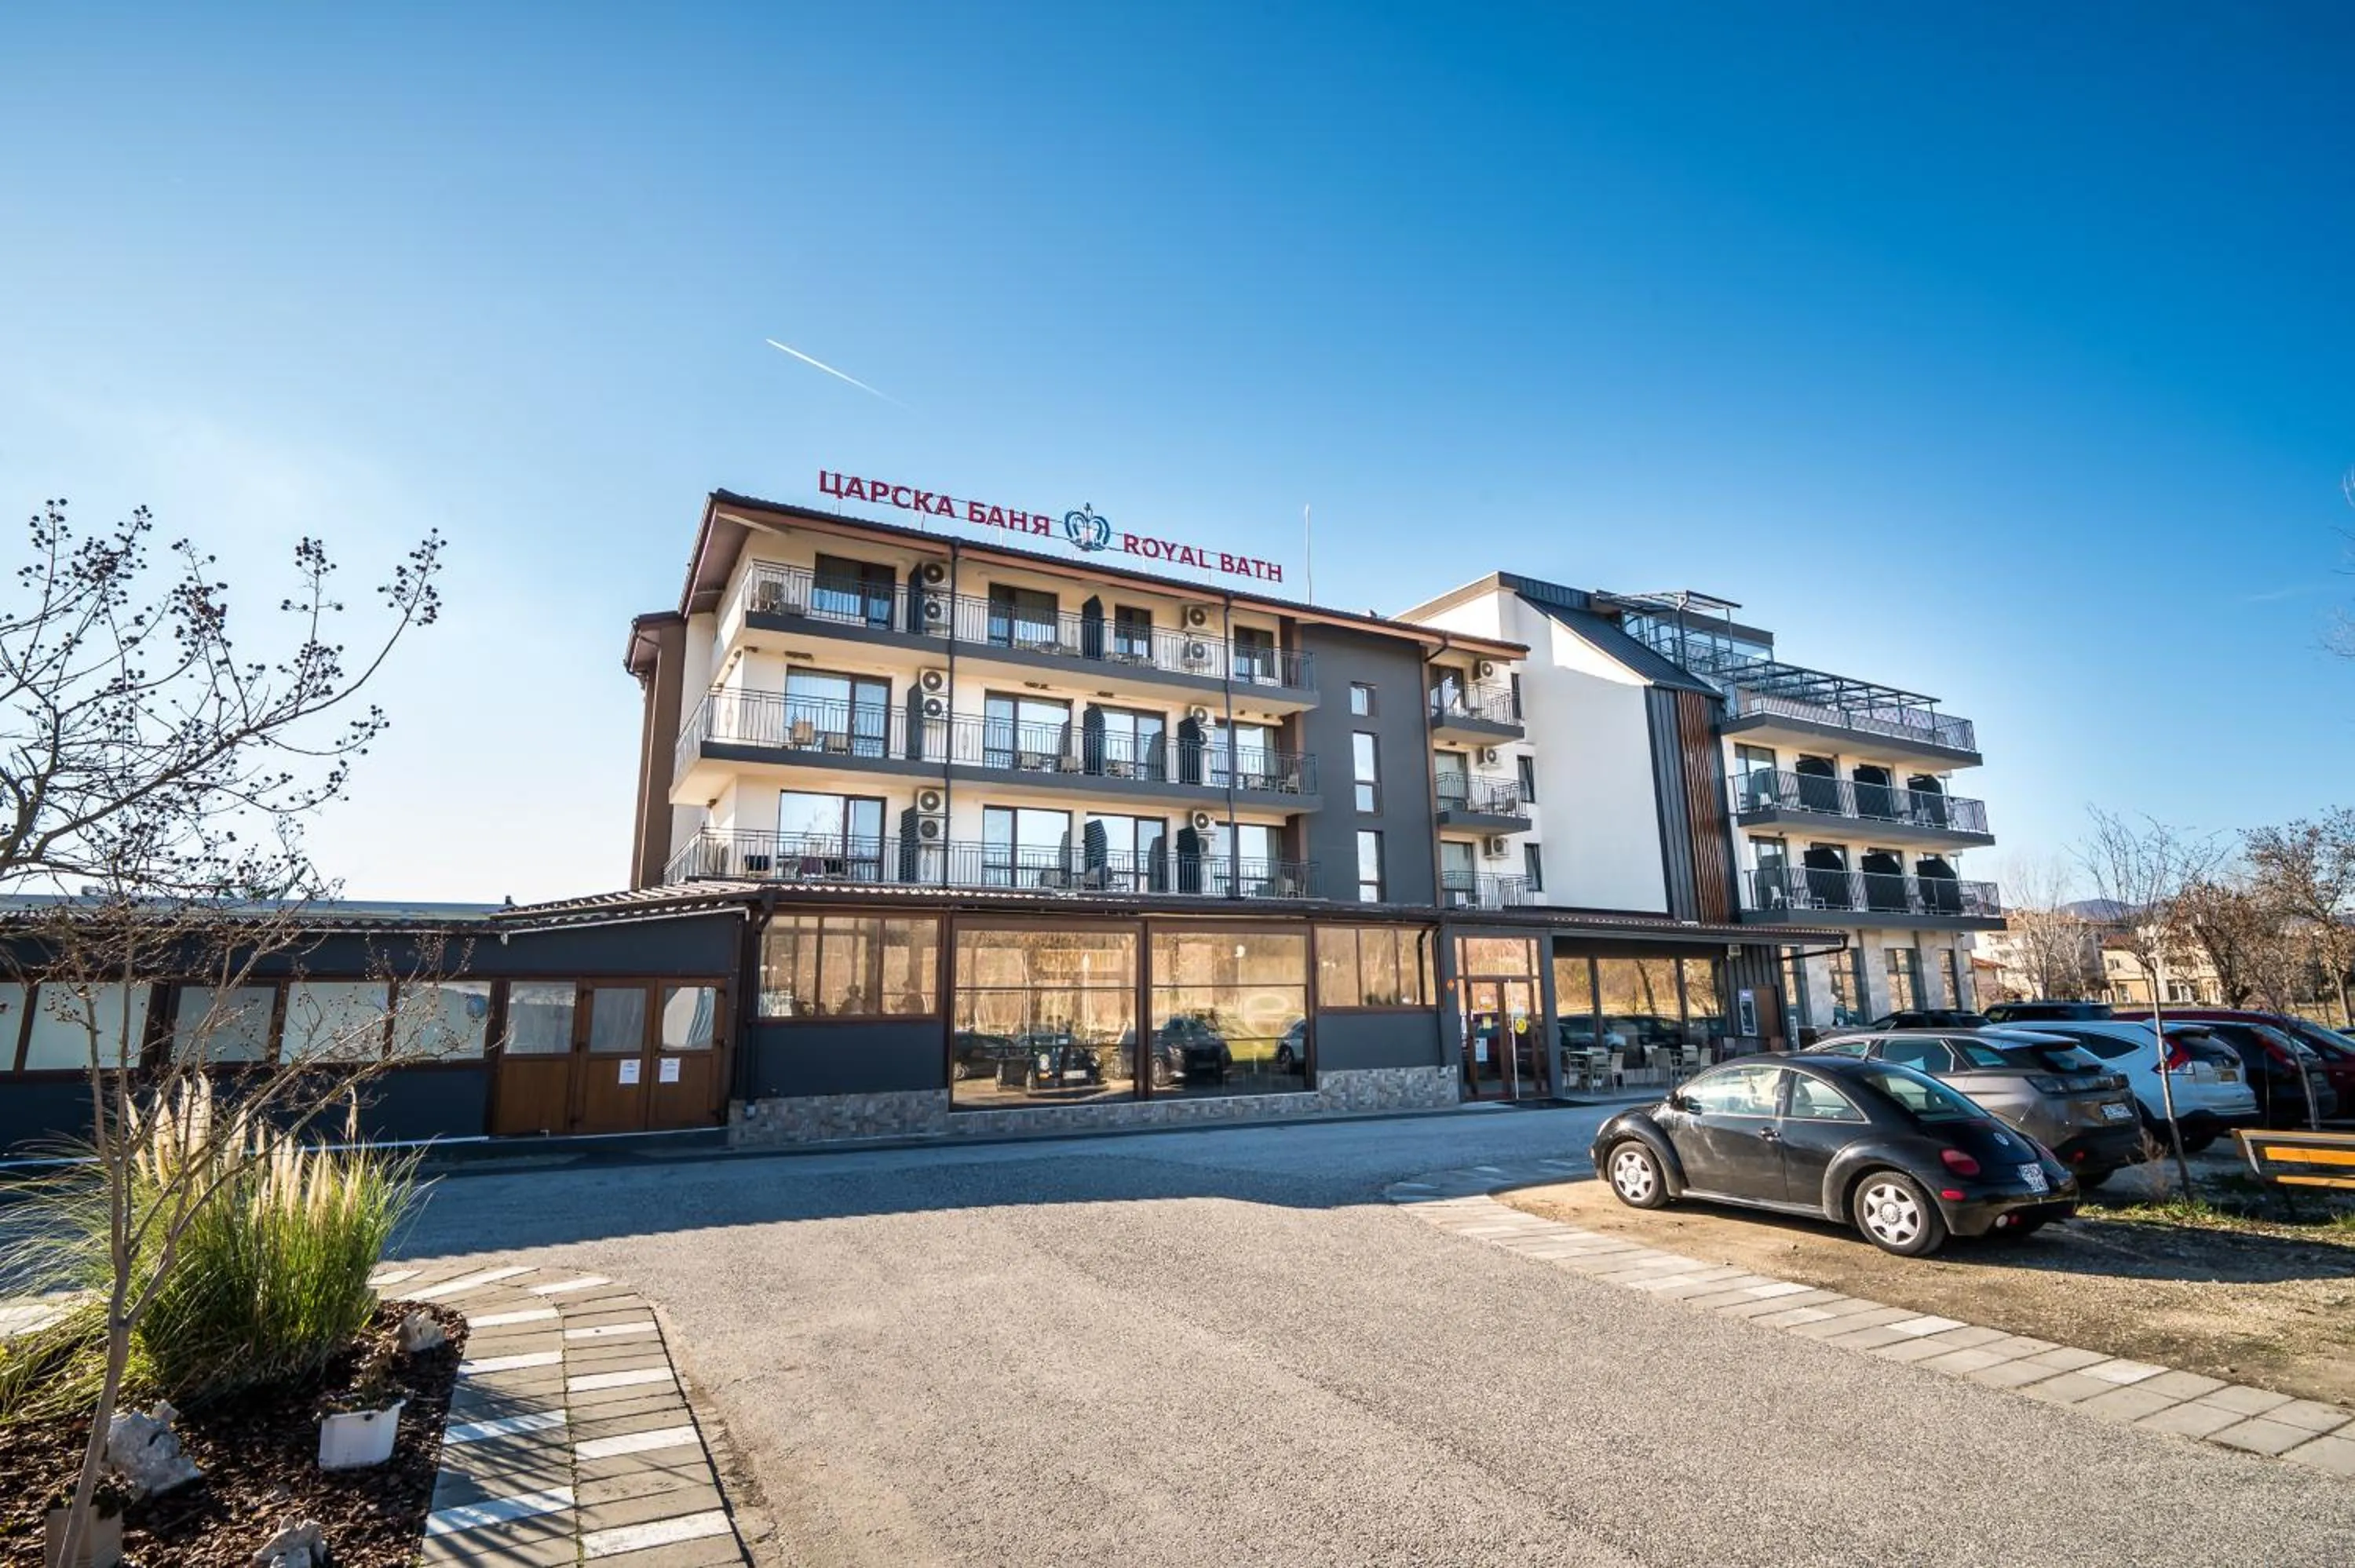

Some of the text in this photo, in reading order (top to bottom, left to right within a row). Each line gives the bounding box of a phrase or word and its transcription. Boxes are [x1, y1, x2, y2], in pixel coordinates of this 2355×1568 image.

[820, 471, 1050, 536] ЦАРСКА БАНЯ
[1123, 534, 1282, 583] ROYAL BATH
